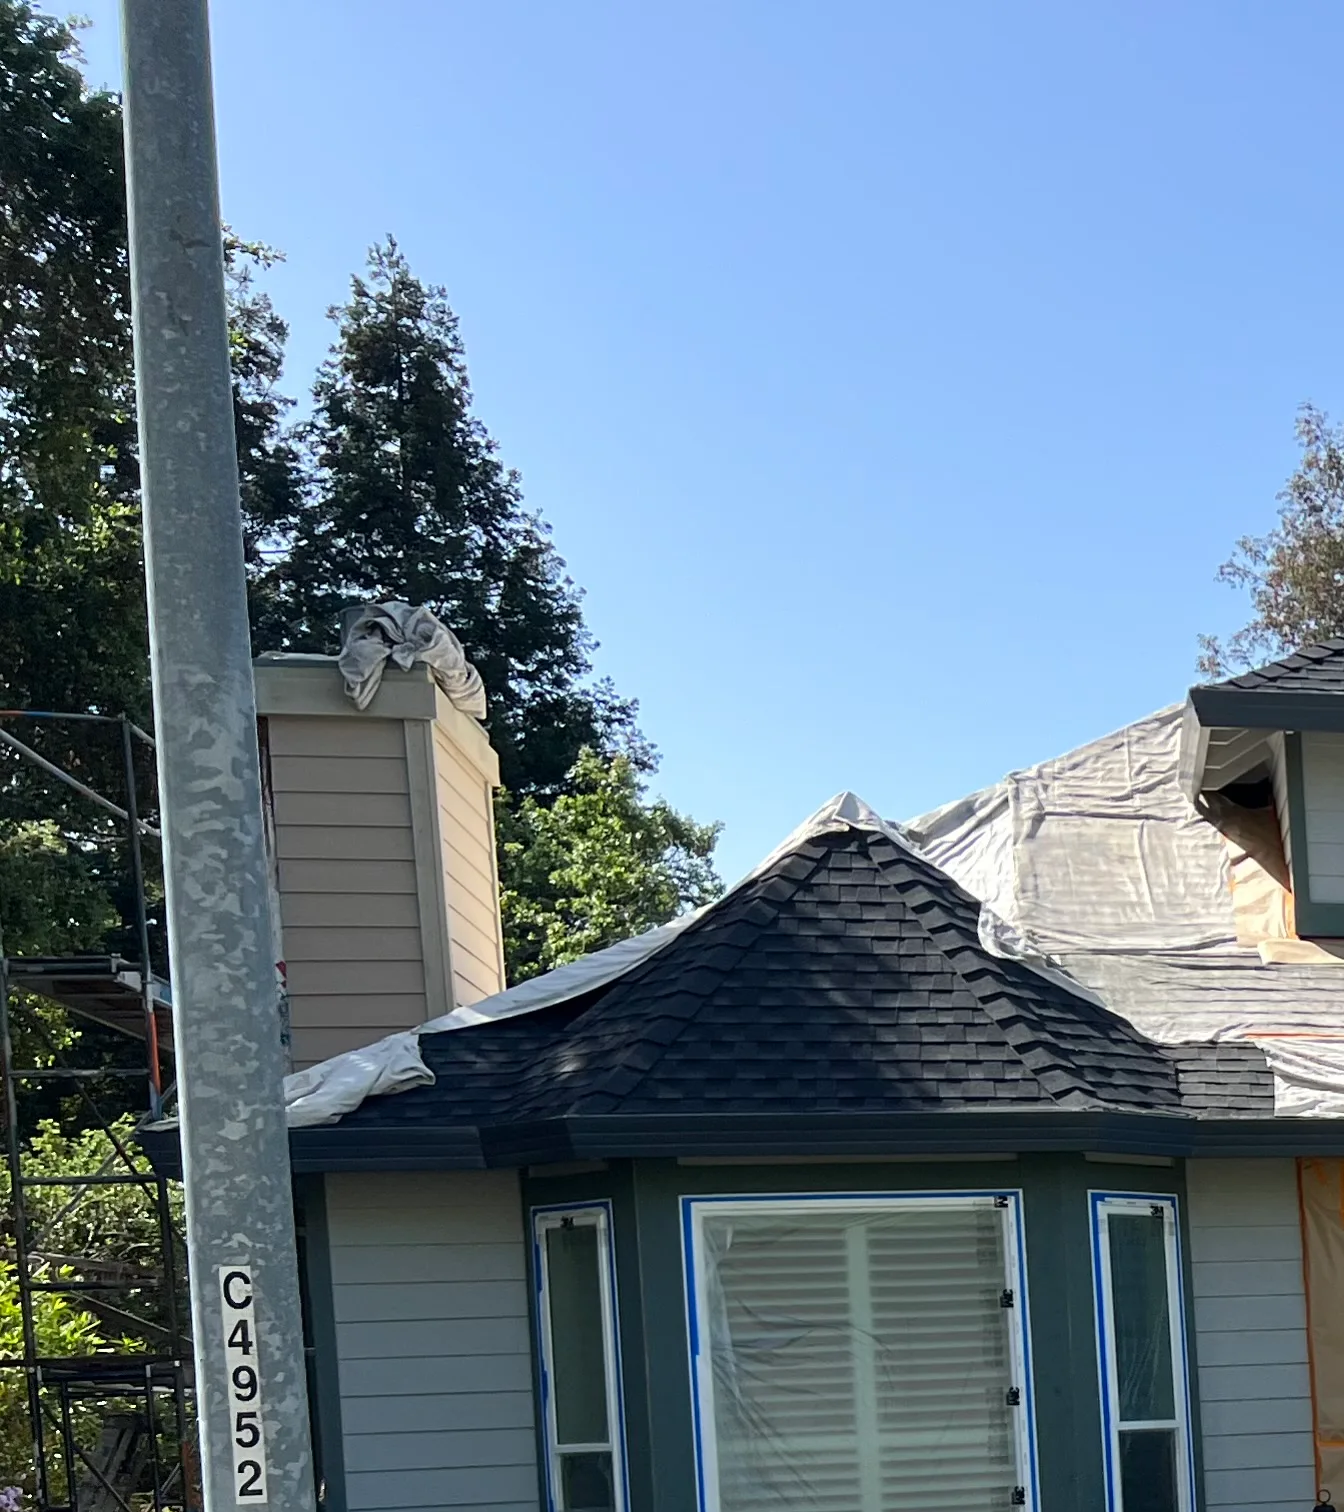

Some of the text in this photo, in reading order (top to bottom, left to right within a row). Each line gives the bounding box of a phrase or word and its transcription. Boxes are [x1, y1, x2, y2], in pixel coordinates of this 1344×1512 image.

[1000, 1289, 1014, 1308] 3M
[223, 1271, 263, 1497] C4952
[1006, 1387, 1020, 1406] 3M
[1011, 1486, 1025, 1505] 3M
